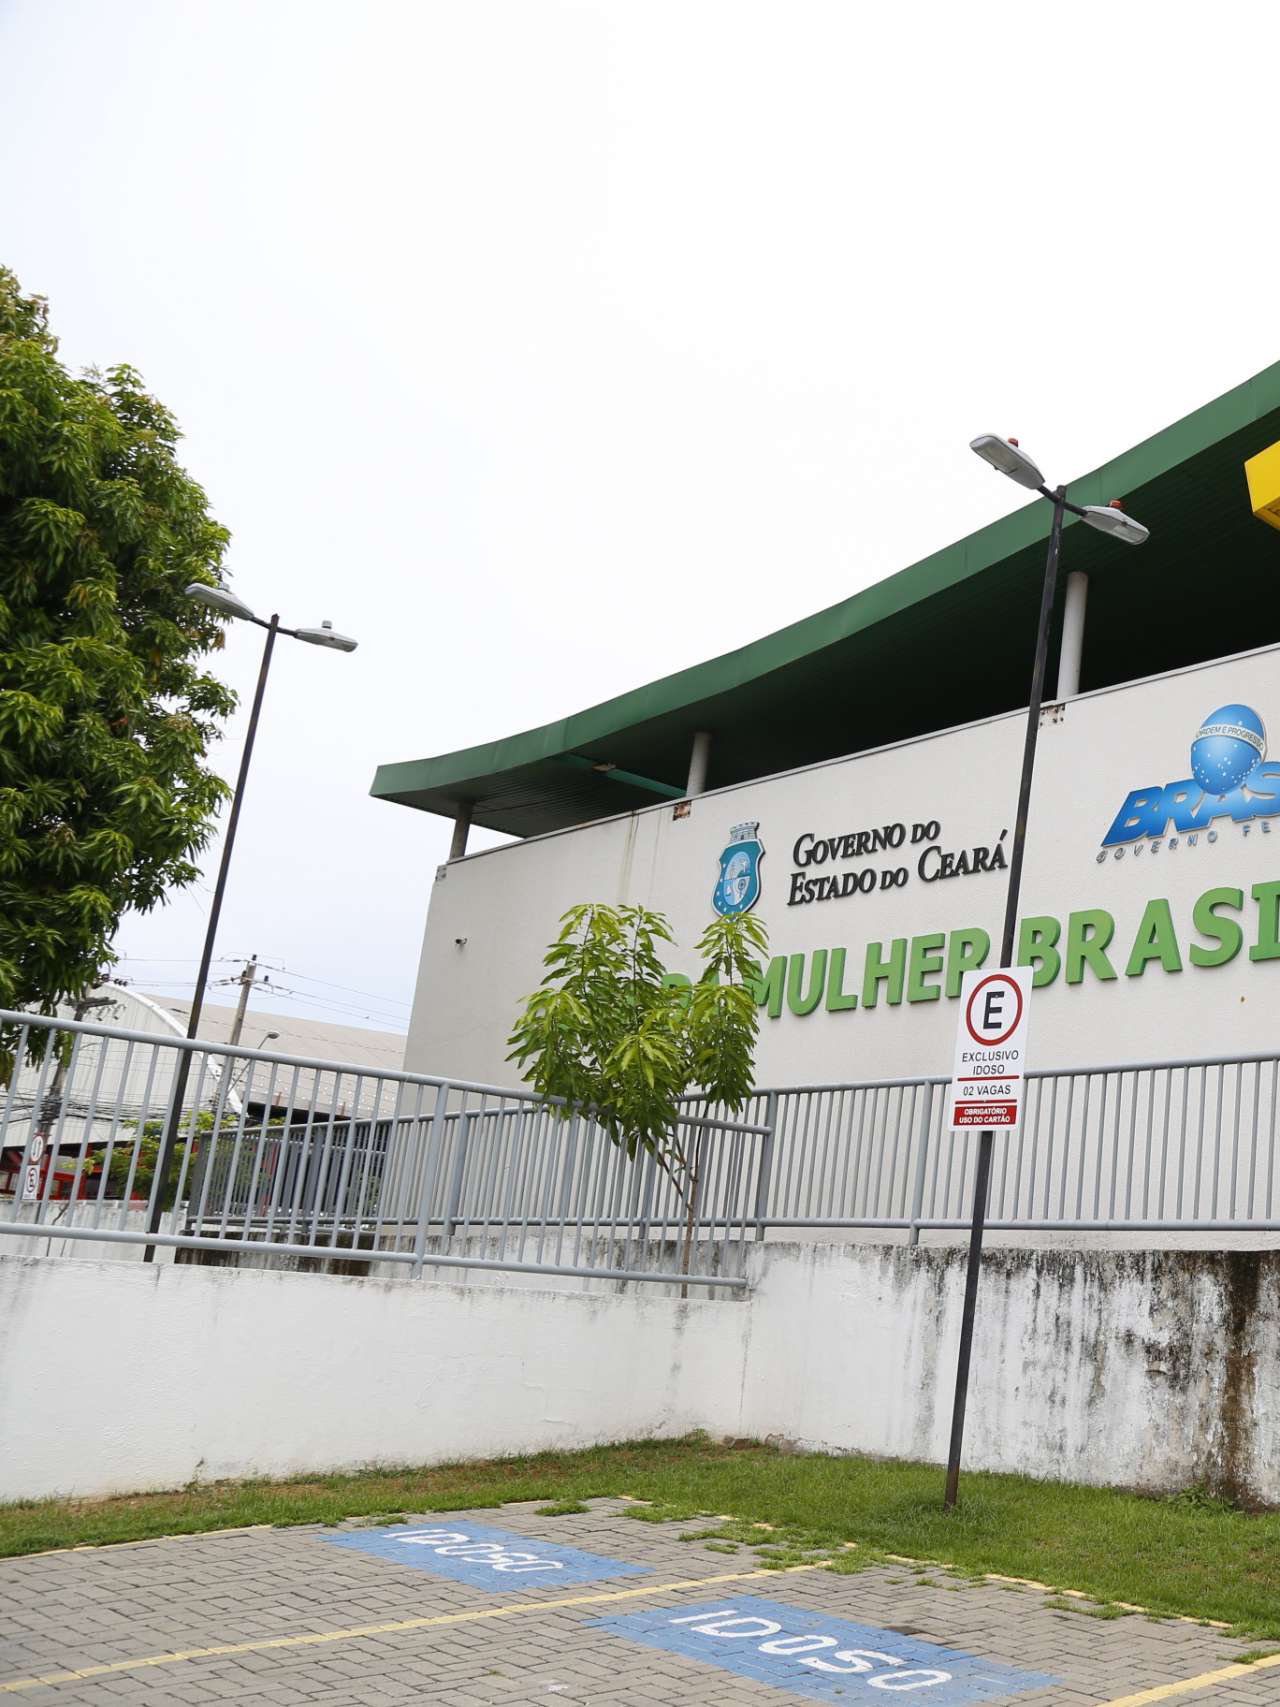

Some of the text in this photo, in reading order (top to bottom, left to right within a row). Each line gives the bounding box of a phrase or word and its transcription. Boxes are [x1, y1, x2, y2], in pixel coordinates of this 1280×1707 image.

[793, 821, 905, 868] GOVERNO
[1096, 830, 1218, 863] GOVERNO
[787, 868, 877, 906] ESTADO
[918, 829, 1008, 882] CEARÁ
[744, 927, 990, 1019] MULHER
[983, 991, 1005, 1029] E
[962, 1050, 1019, 1062] EXCLUSIVO
[973, 1064, 1005, 1075] IDOSO
[963, 1084, 1011, 1096] 02 VAGAS
[383, 1528, 564, 1573] IDOSO
[668, 1609, 952, 1692] IDOSO
